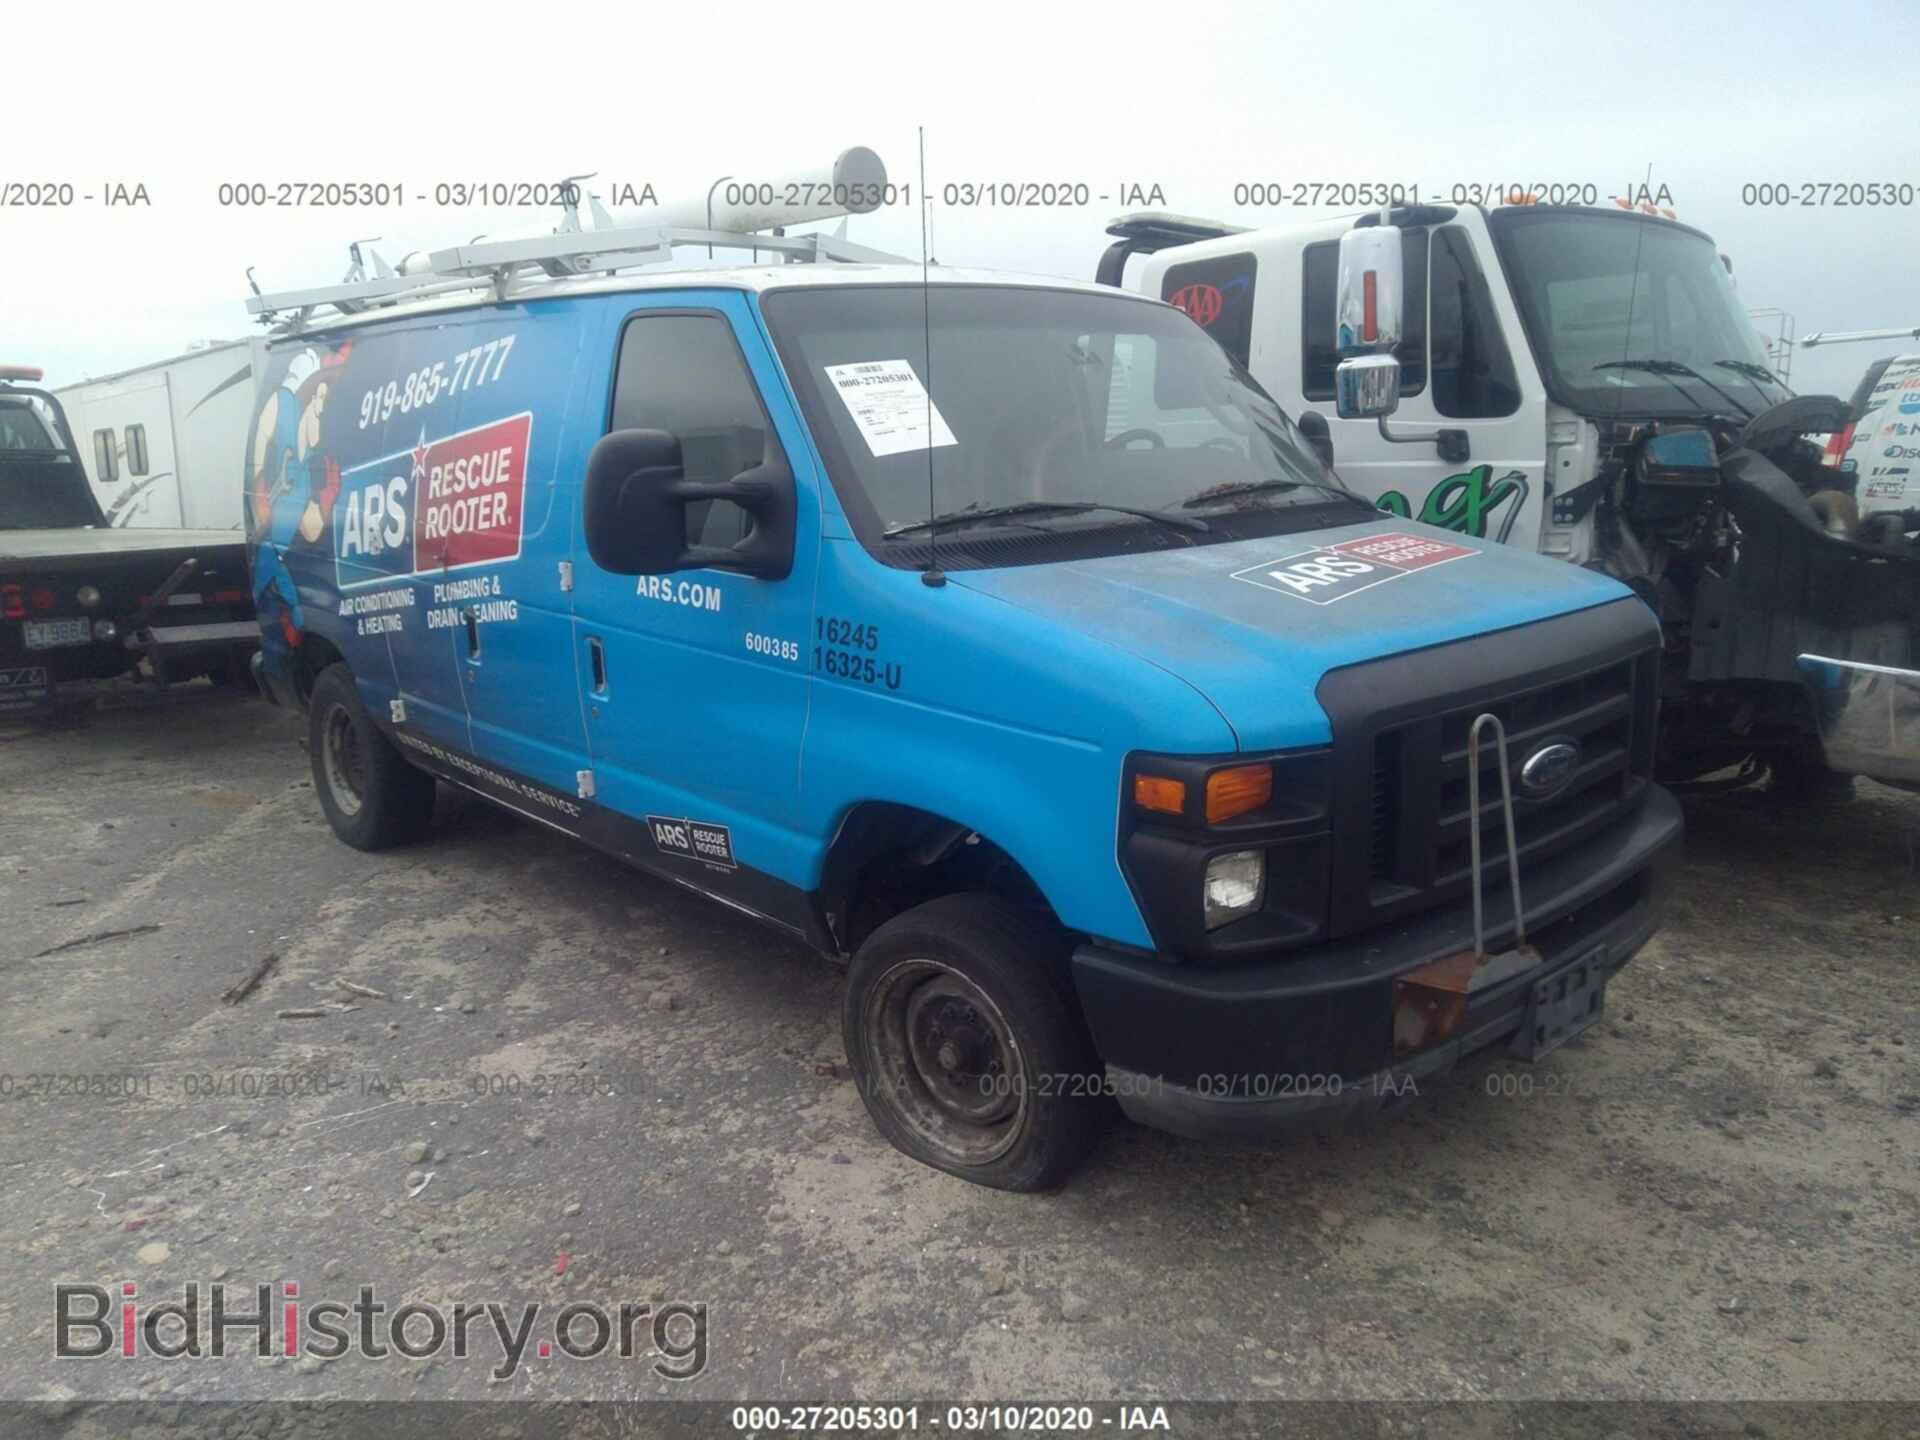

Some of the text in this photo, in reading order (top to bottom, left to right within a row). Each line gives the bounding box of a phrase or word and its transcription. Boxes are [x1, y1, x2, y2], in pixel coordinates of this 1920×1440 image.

[359, 334, 516, 429] 919-865-7777
[428, 447, 512, 499] RESCUE
[341, 477, 407, 557] ARS
[434, 575, 501, 603] PLUMBING &
[1268, 556, 1375, 593] ARS
[636, 575, 721, 611] ARS.COM
[426, 600, 518, 629] DRAIN CEANING
[745, 632, 799, 661] 600385
[815, 616, 879, 650] 16245
[814, 648, 901, 689] 16325-U
[655, 823, 689, 849] ARS
[693, 829, 726, 846] RESCUE
